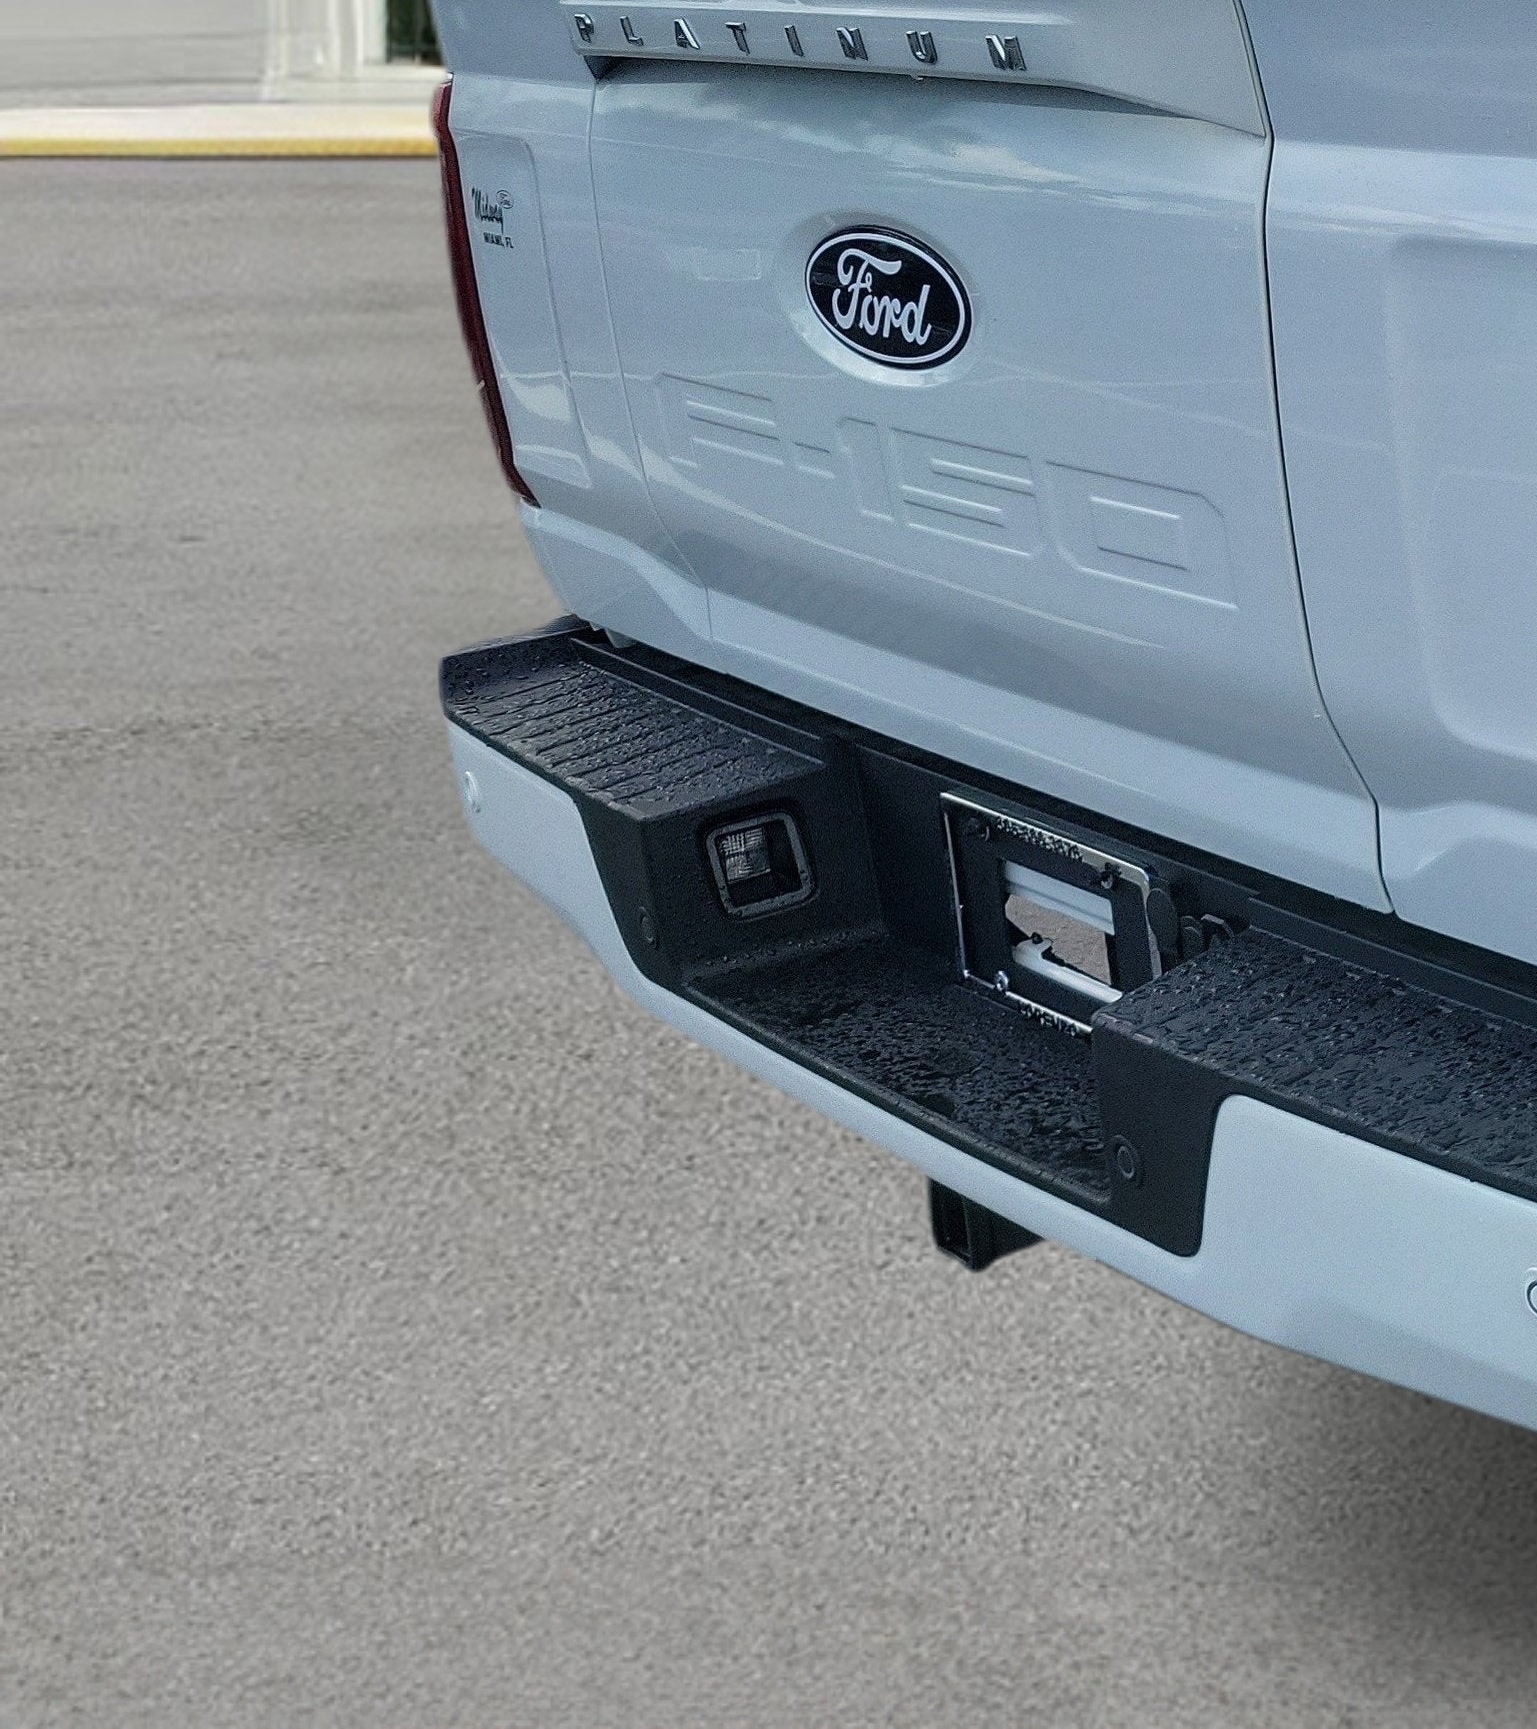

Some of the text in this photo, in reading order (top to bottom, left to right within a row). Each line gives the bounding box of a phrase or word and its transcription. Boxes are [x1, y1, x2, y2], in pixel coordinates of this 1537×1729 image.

[573, 13, 1028, 72] PLATINUM
[831, 247, 933, 346] Ford
[655, 371, 1240, 611] F-150
